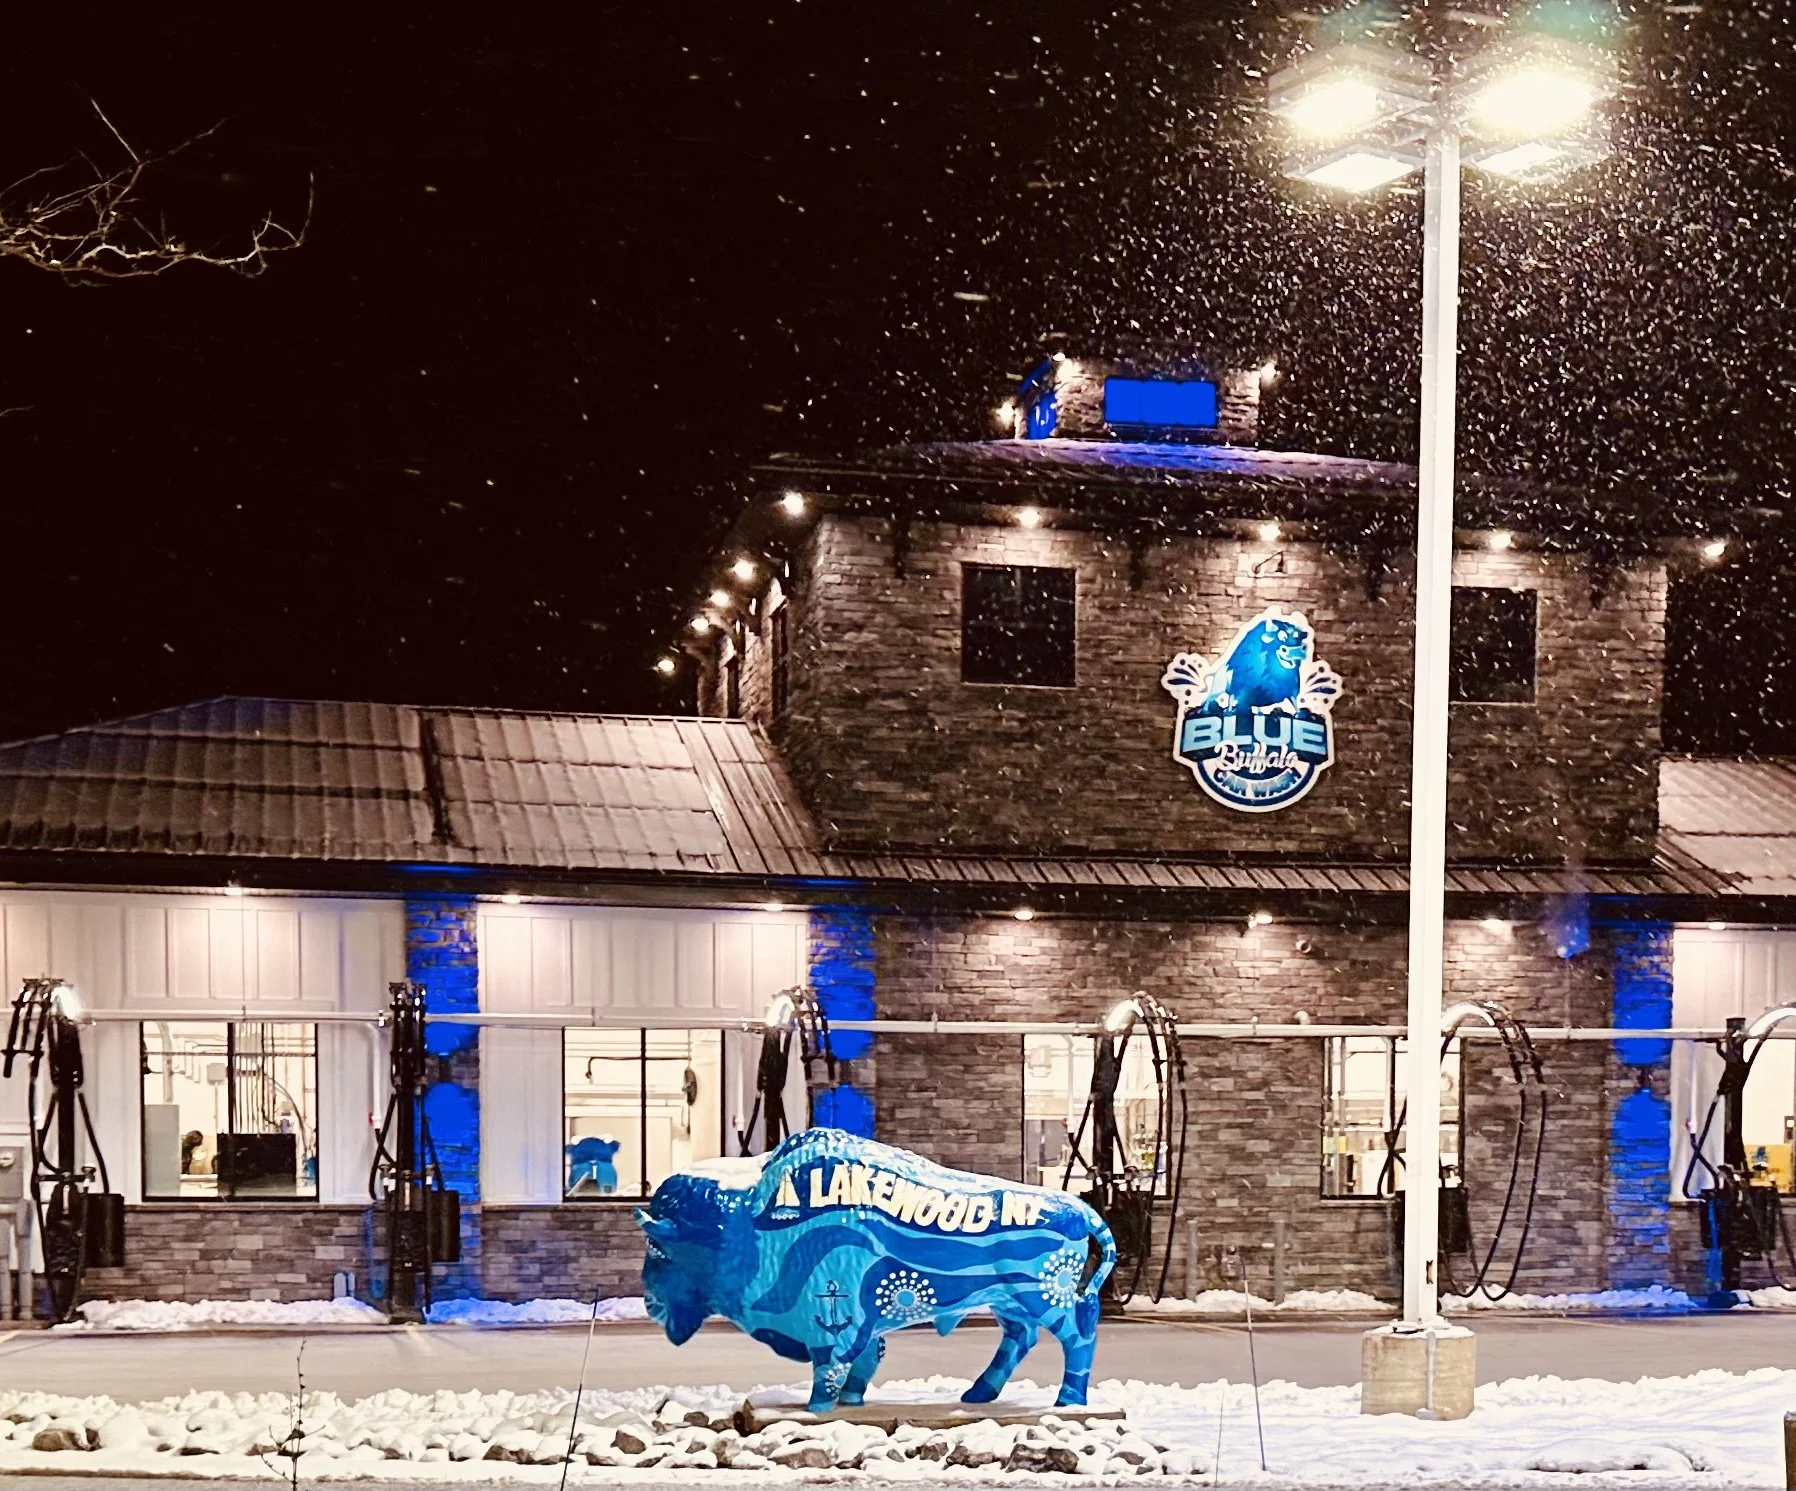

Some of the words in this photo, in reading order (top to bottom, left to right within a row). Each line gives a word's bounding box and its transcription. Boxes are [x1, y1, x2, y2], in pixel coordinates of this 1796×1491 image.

[1182, 715, 1326, 755] BLUE
[1214, 740, 1298, 774] Buffalo
[809, 1164, 994, 1233] LAKEWOOD
